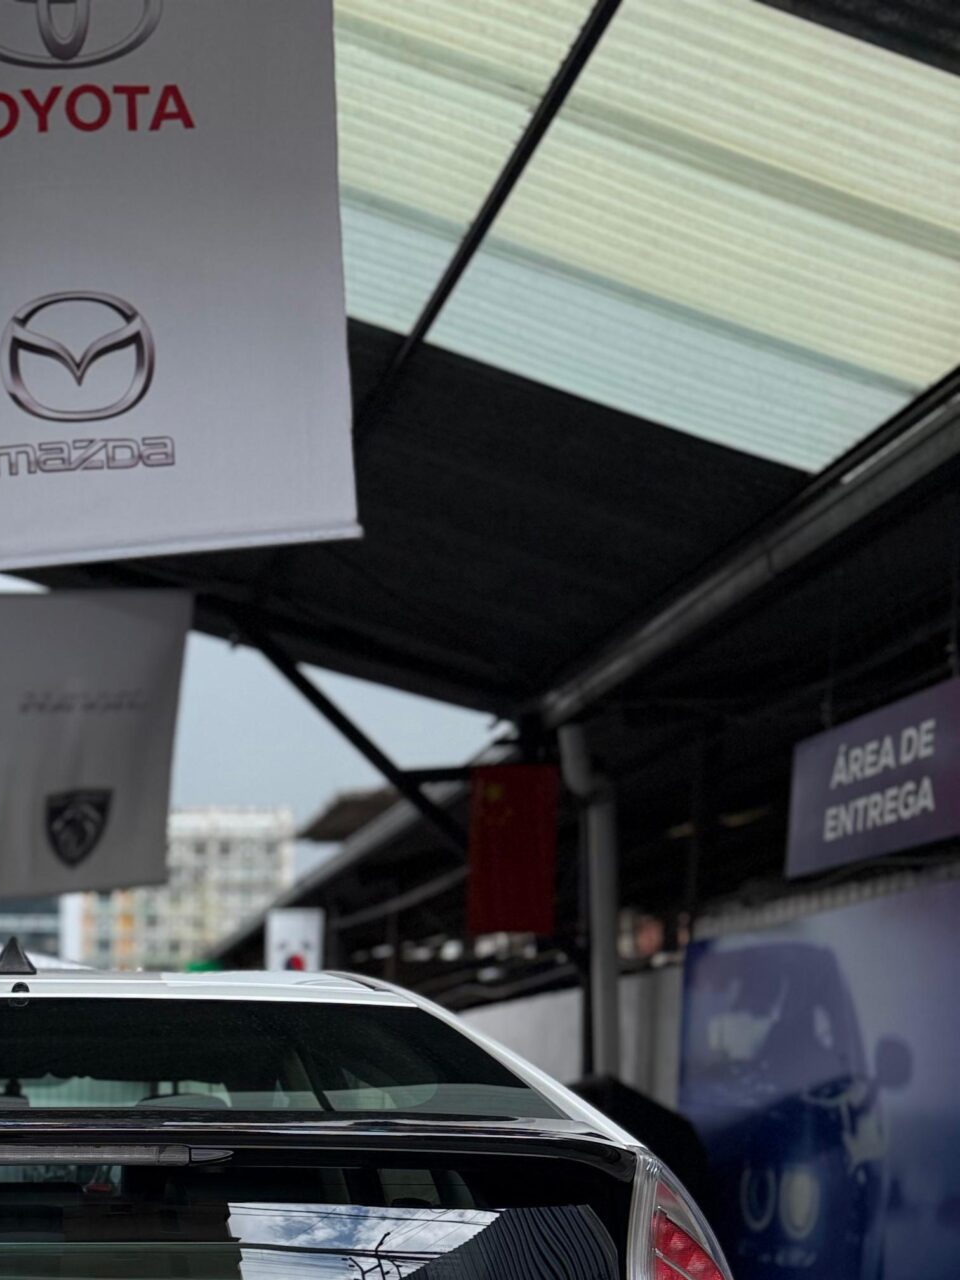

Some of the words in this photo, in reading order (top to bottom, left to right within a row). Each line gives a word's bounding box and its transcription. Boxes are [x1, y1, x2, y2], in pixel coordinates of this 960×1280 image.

[829, 735, 896, 789] ÁREA
[900, 718, 937, 766] DE
[823, 775, 936, 842] ENTREGA
